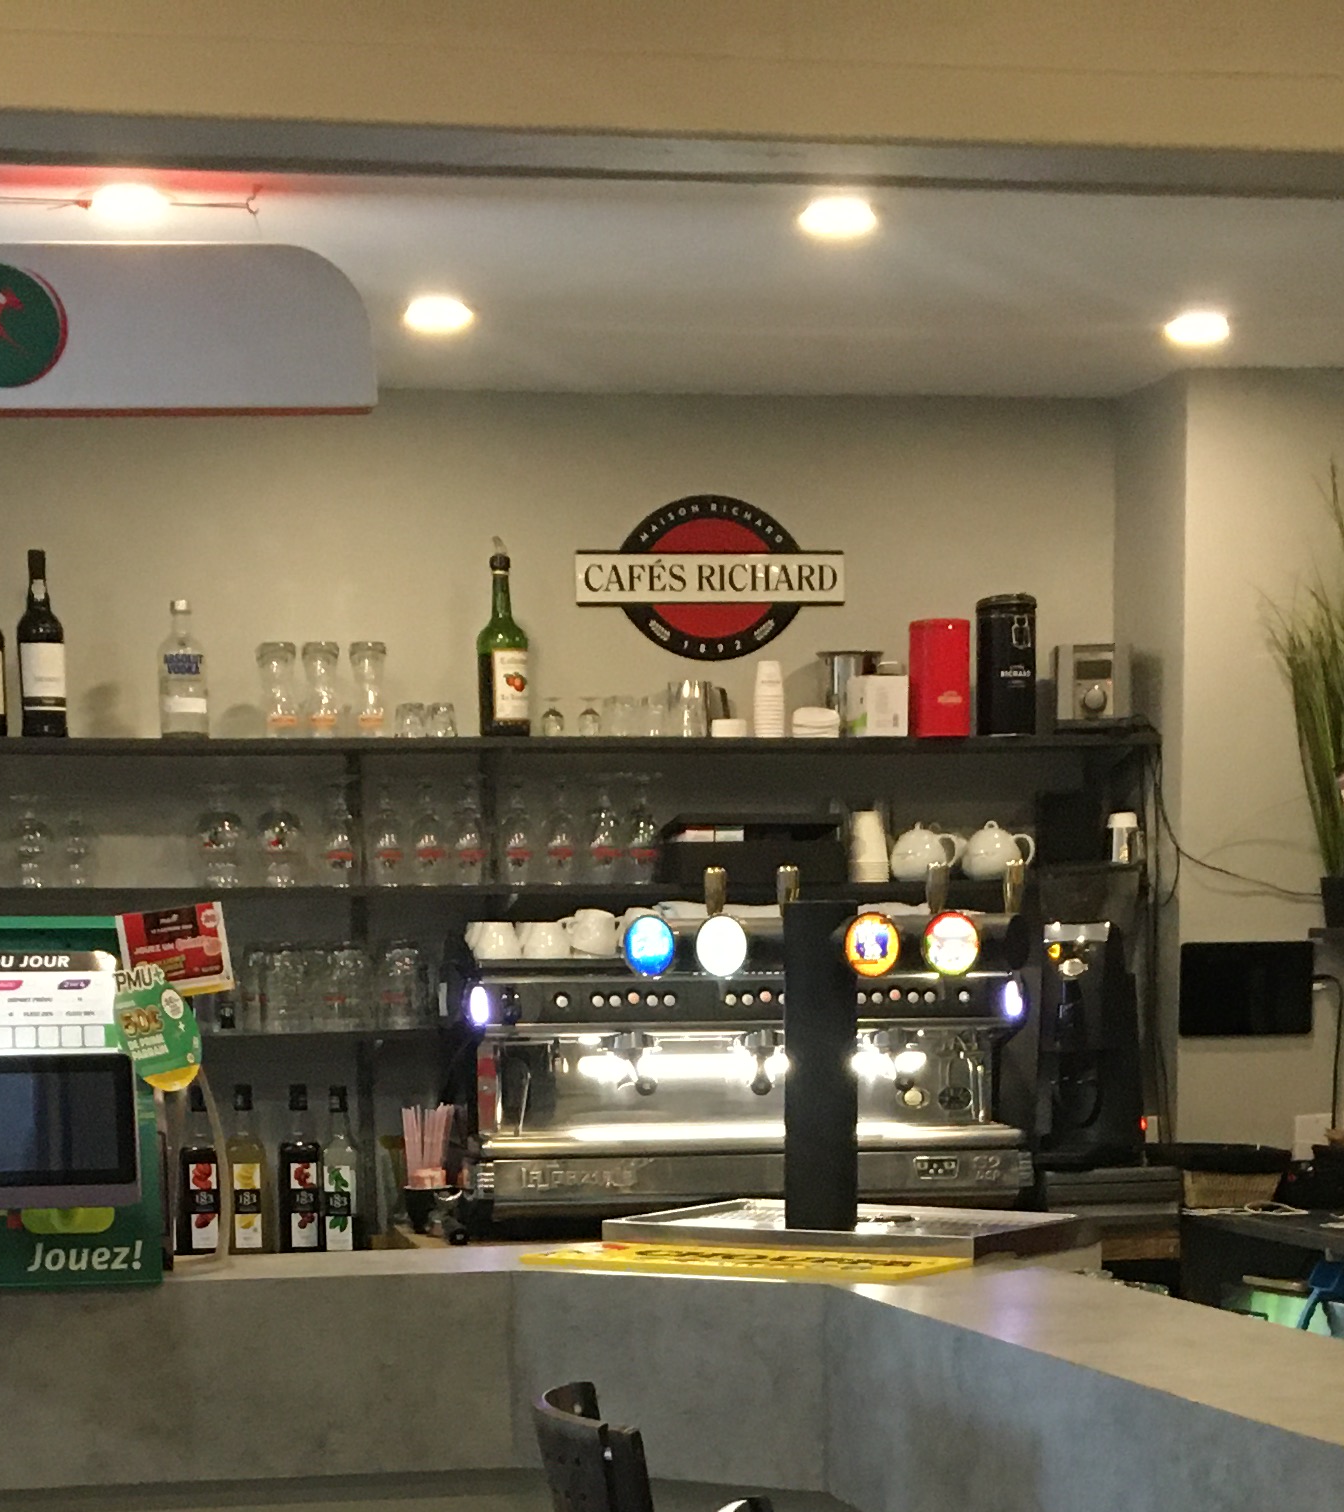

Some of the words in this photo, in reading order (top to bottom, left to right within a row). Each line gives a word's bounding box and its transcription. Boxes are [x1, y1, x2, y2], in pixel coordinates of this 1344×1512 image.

[638, 503, 700, 543] MAISON
[710, 502, 784, 544] RICHARD
[584, 559, 687, 592] CAFÉS
[696, 563, 838, 592] RICHARD
[682, 639, 743, 654] 1892
[164, 654, 203, 664] ABSOLUT
[167, 663, 201, 675] VODKA
[19, 955, 71, 968] JOUR
[120, 1004, 164, 1037] 50€
[27, 1239, 144, 1272] Jouez!
